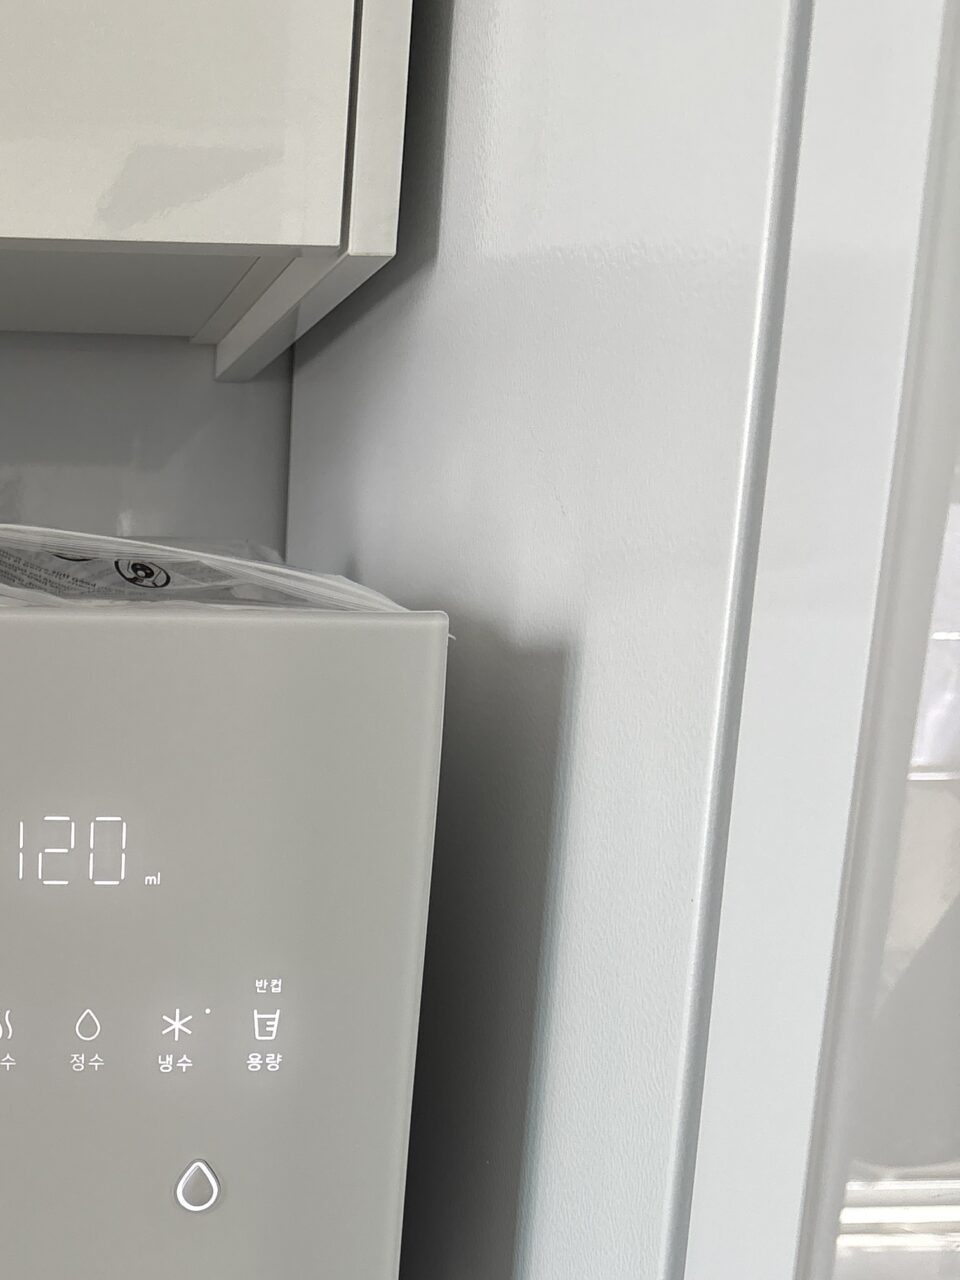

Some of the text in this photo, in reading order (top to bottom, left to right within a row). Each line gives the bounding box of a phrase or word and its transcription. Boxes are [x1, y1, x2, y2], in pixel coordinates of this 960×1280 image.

[19, 816, 161, 885] 120 ml
[255, 978, 282, 993] 반컵
[70, 1052, 105, 1072] 정수
[158, 1054, 193, 1073] 냉수
[246, 1052, 283, 1072] 용량
